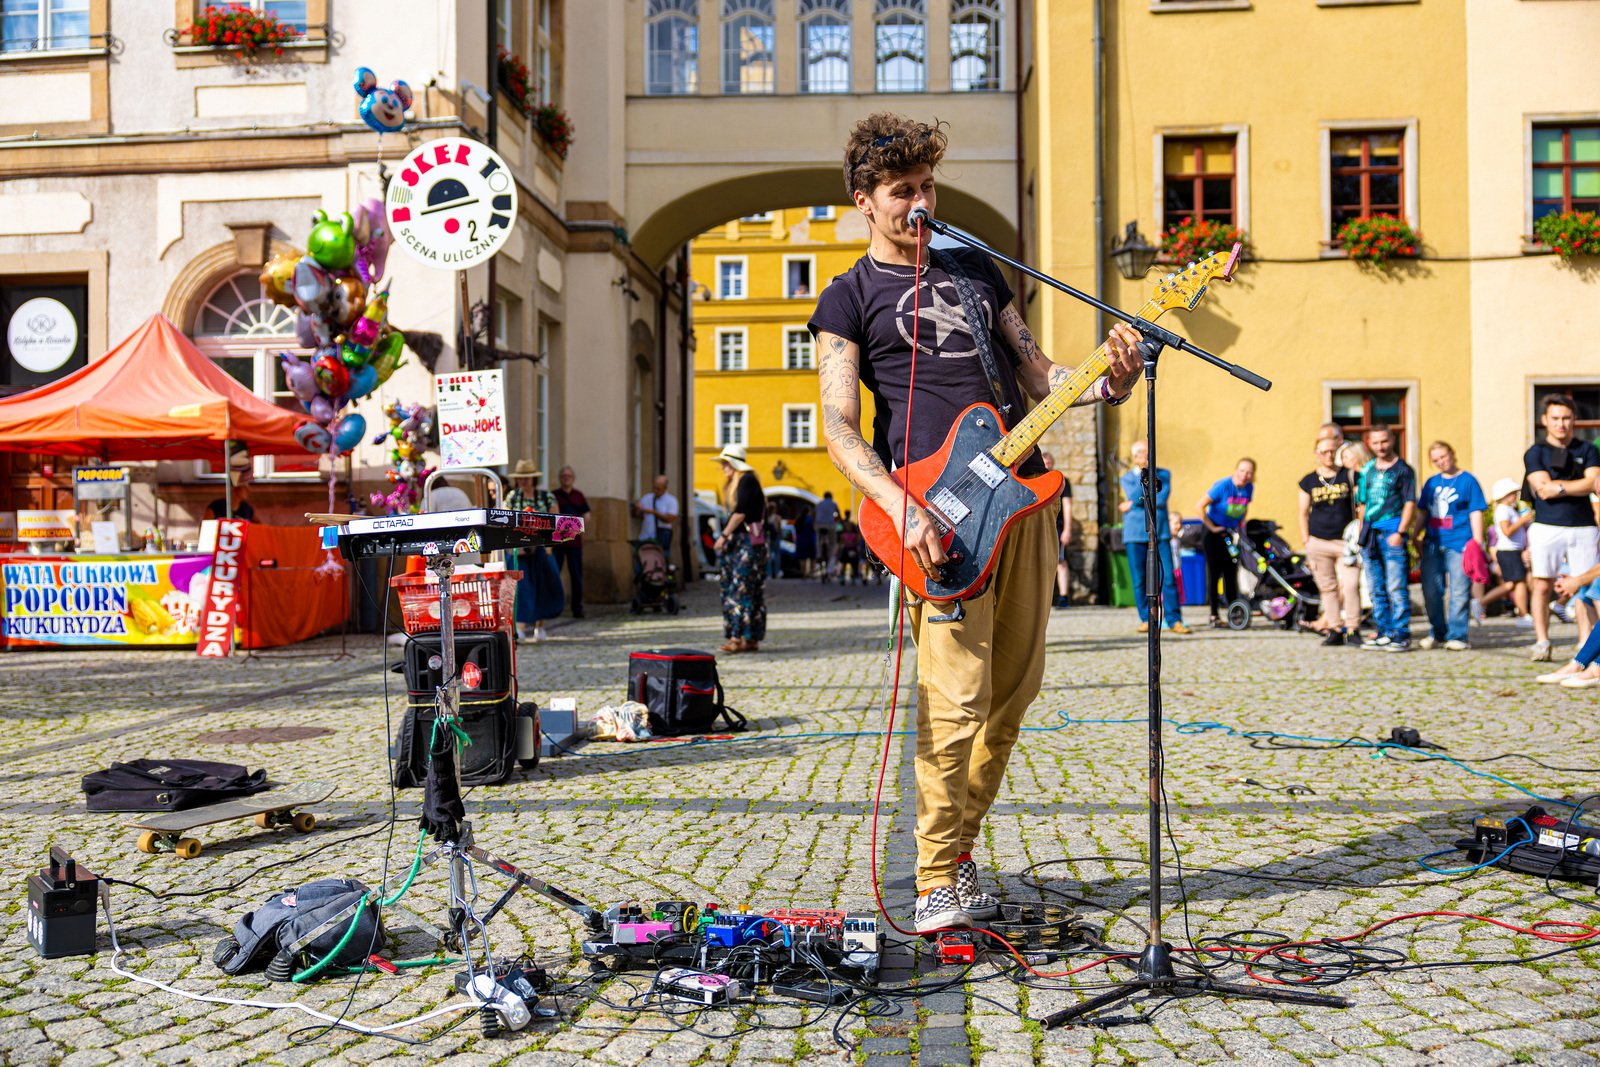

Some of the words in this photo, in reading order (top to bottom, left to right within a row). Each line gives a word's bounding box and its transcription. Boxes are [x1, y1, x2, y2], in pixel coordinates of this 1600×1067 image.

[479, 156, 512, 230] TOUR
[467, 219, 479, 242] 2
[400, 227, 437, 261] SCENA
[77, 468, 123, 481] POPCORN
[372, 518, 414, 530] OCTAPAD
[4, 564, 56, 585] WATA
[60, 563, 158, 585] CUKROWA
[5, 586, 128, 613] POPCORN
[201, 520, 243, 656] KUKURYDZA
[7, 616, 126, 636] KUKURYDZA
